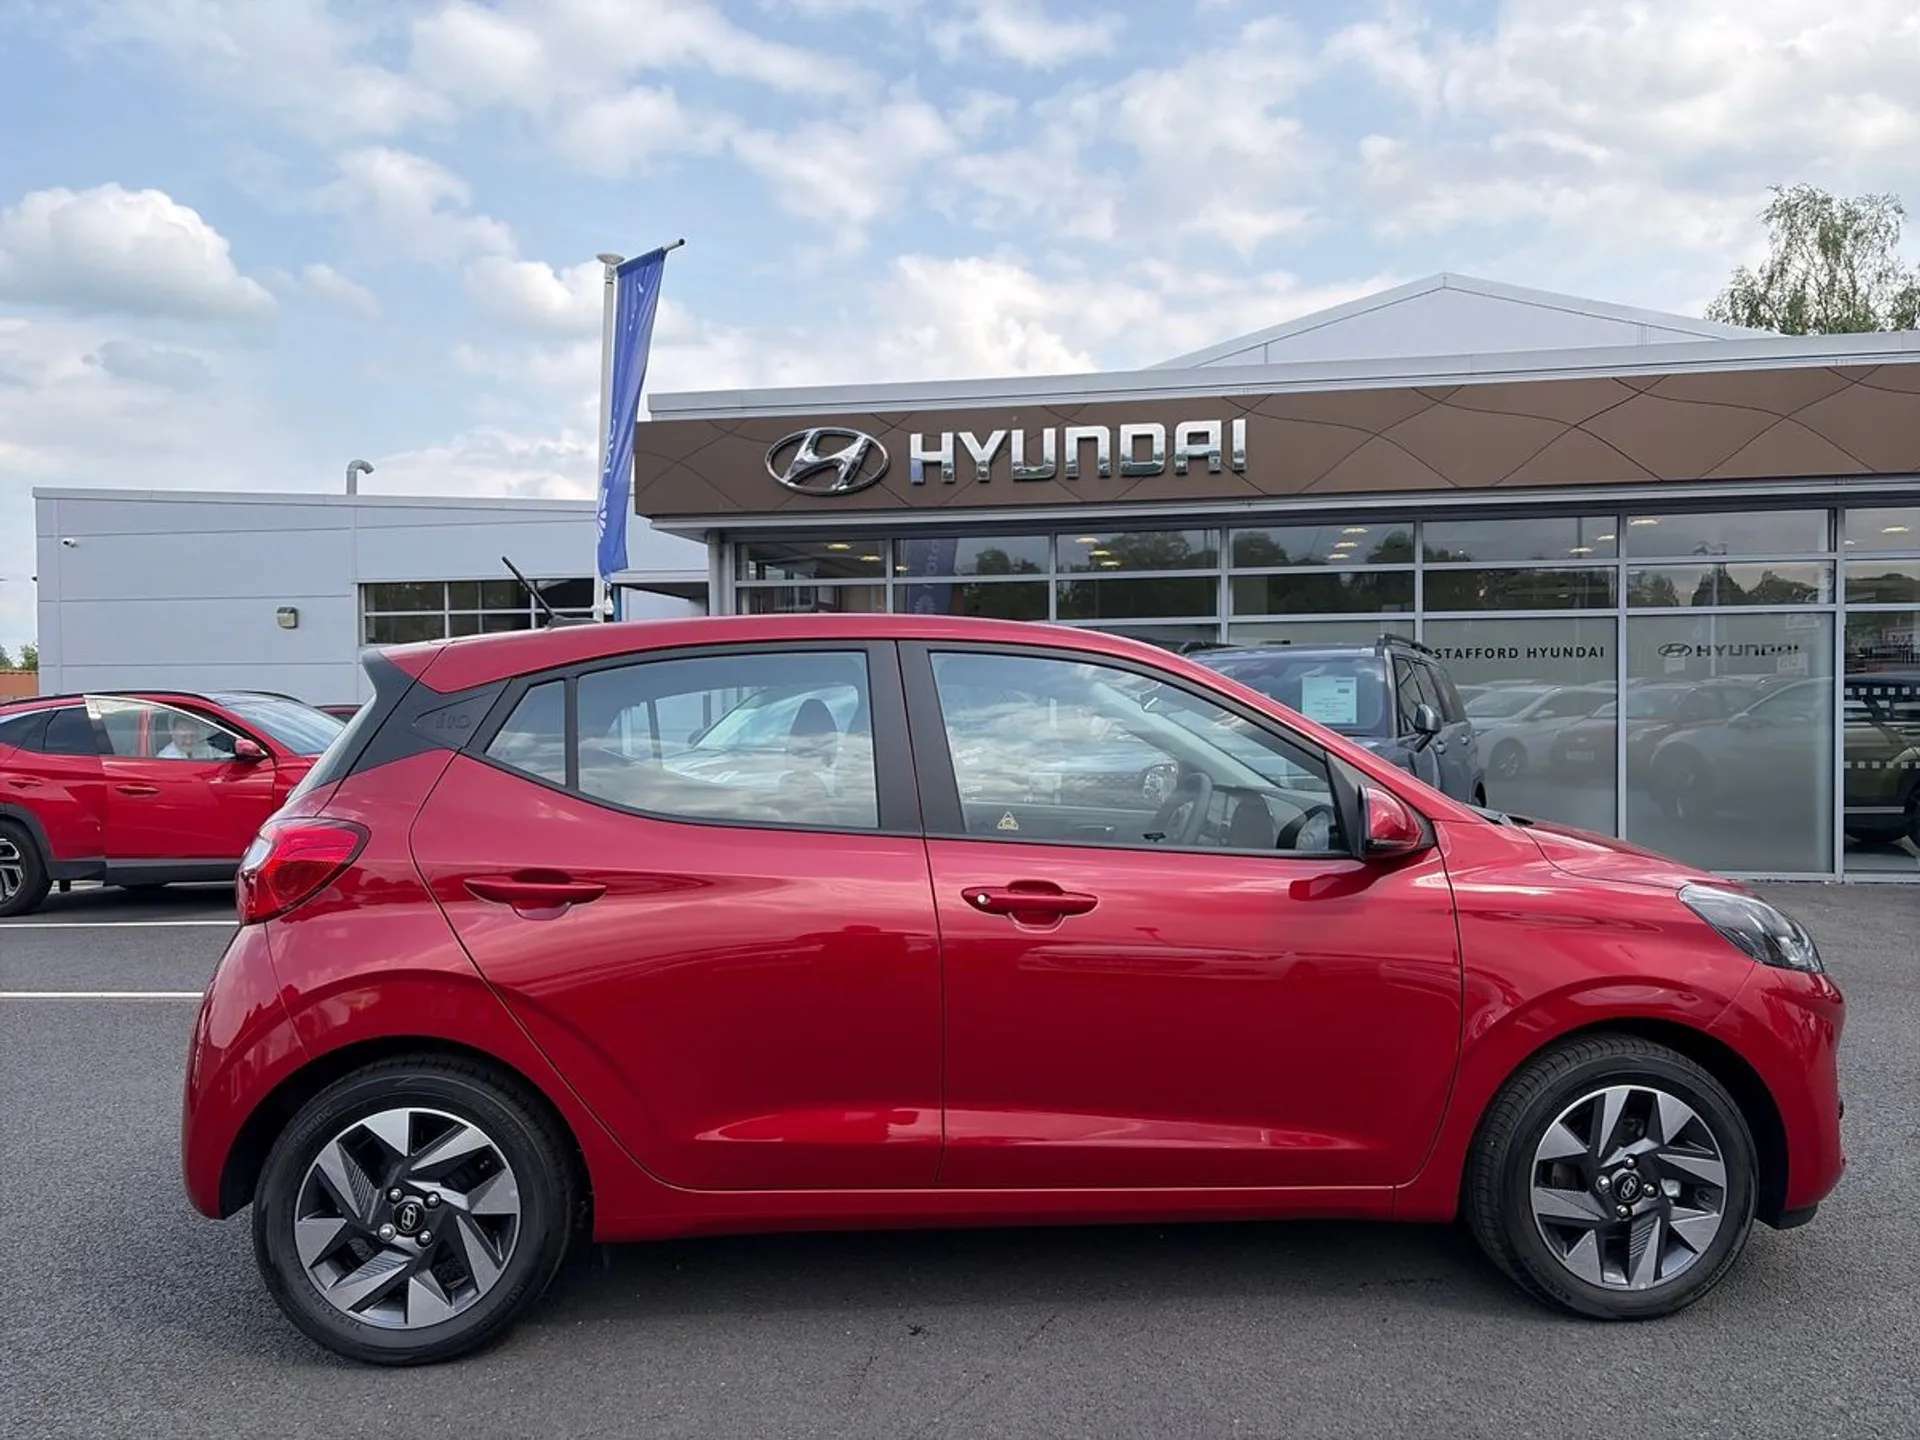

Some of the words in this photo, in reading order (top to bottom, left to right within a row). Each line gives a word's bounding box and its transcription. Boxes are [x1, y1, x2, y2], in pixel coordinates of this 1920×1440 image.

[909, 418, 1248, 486] HYUNDAI
[1434, 647, 1519, 660] STAFFORD
[1526, 646, 1605, 659] HYUNDAI
